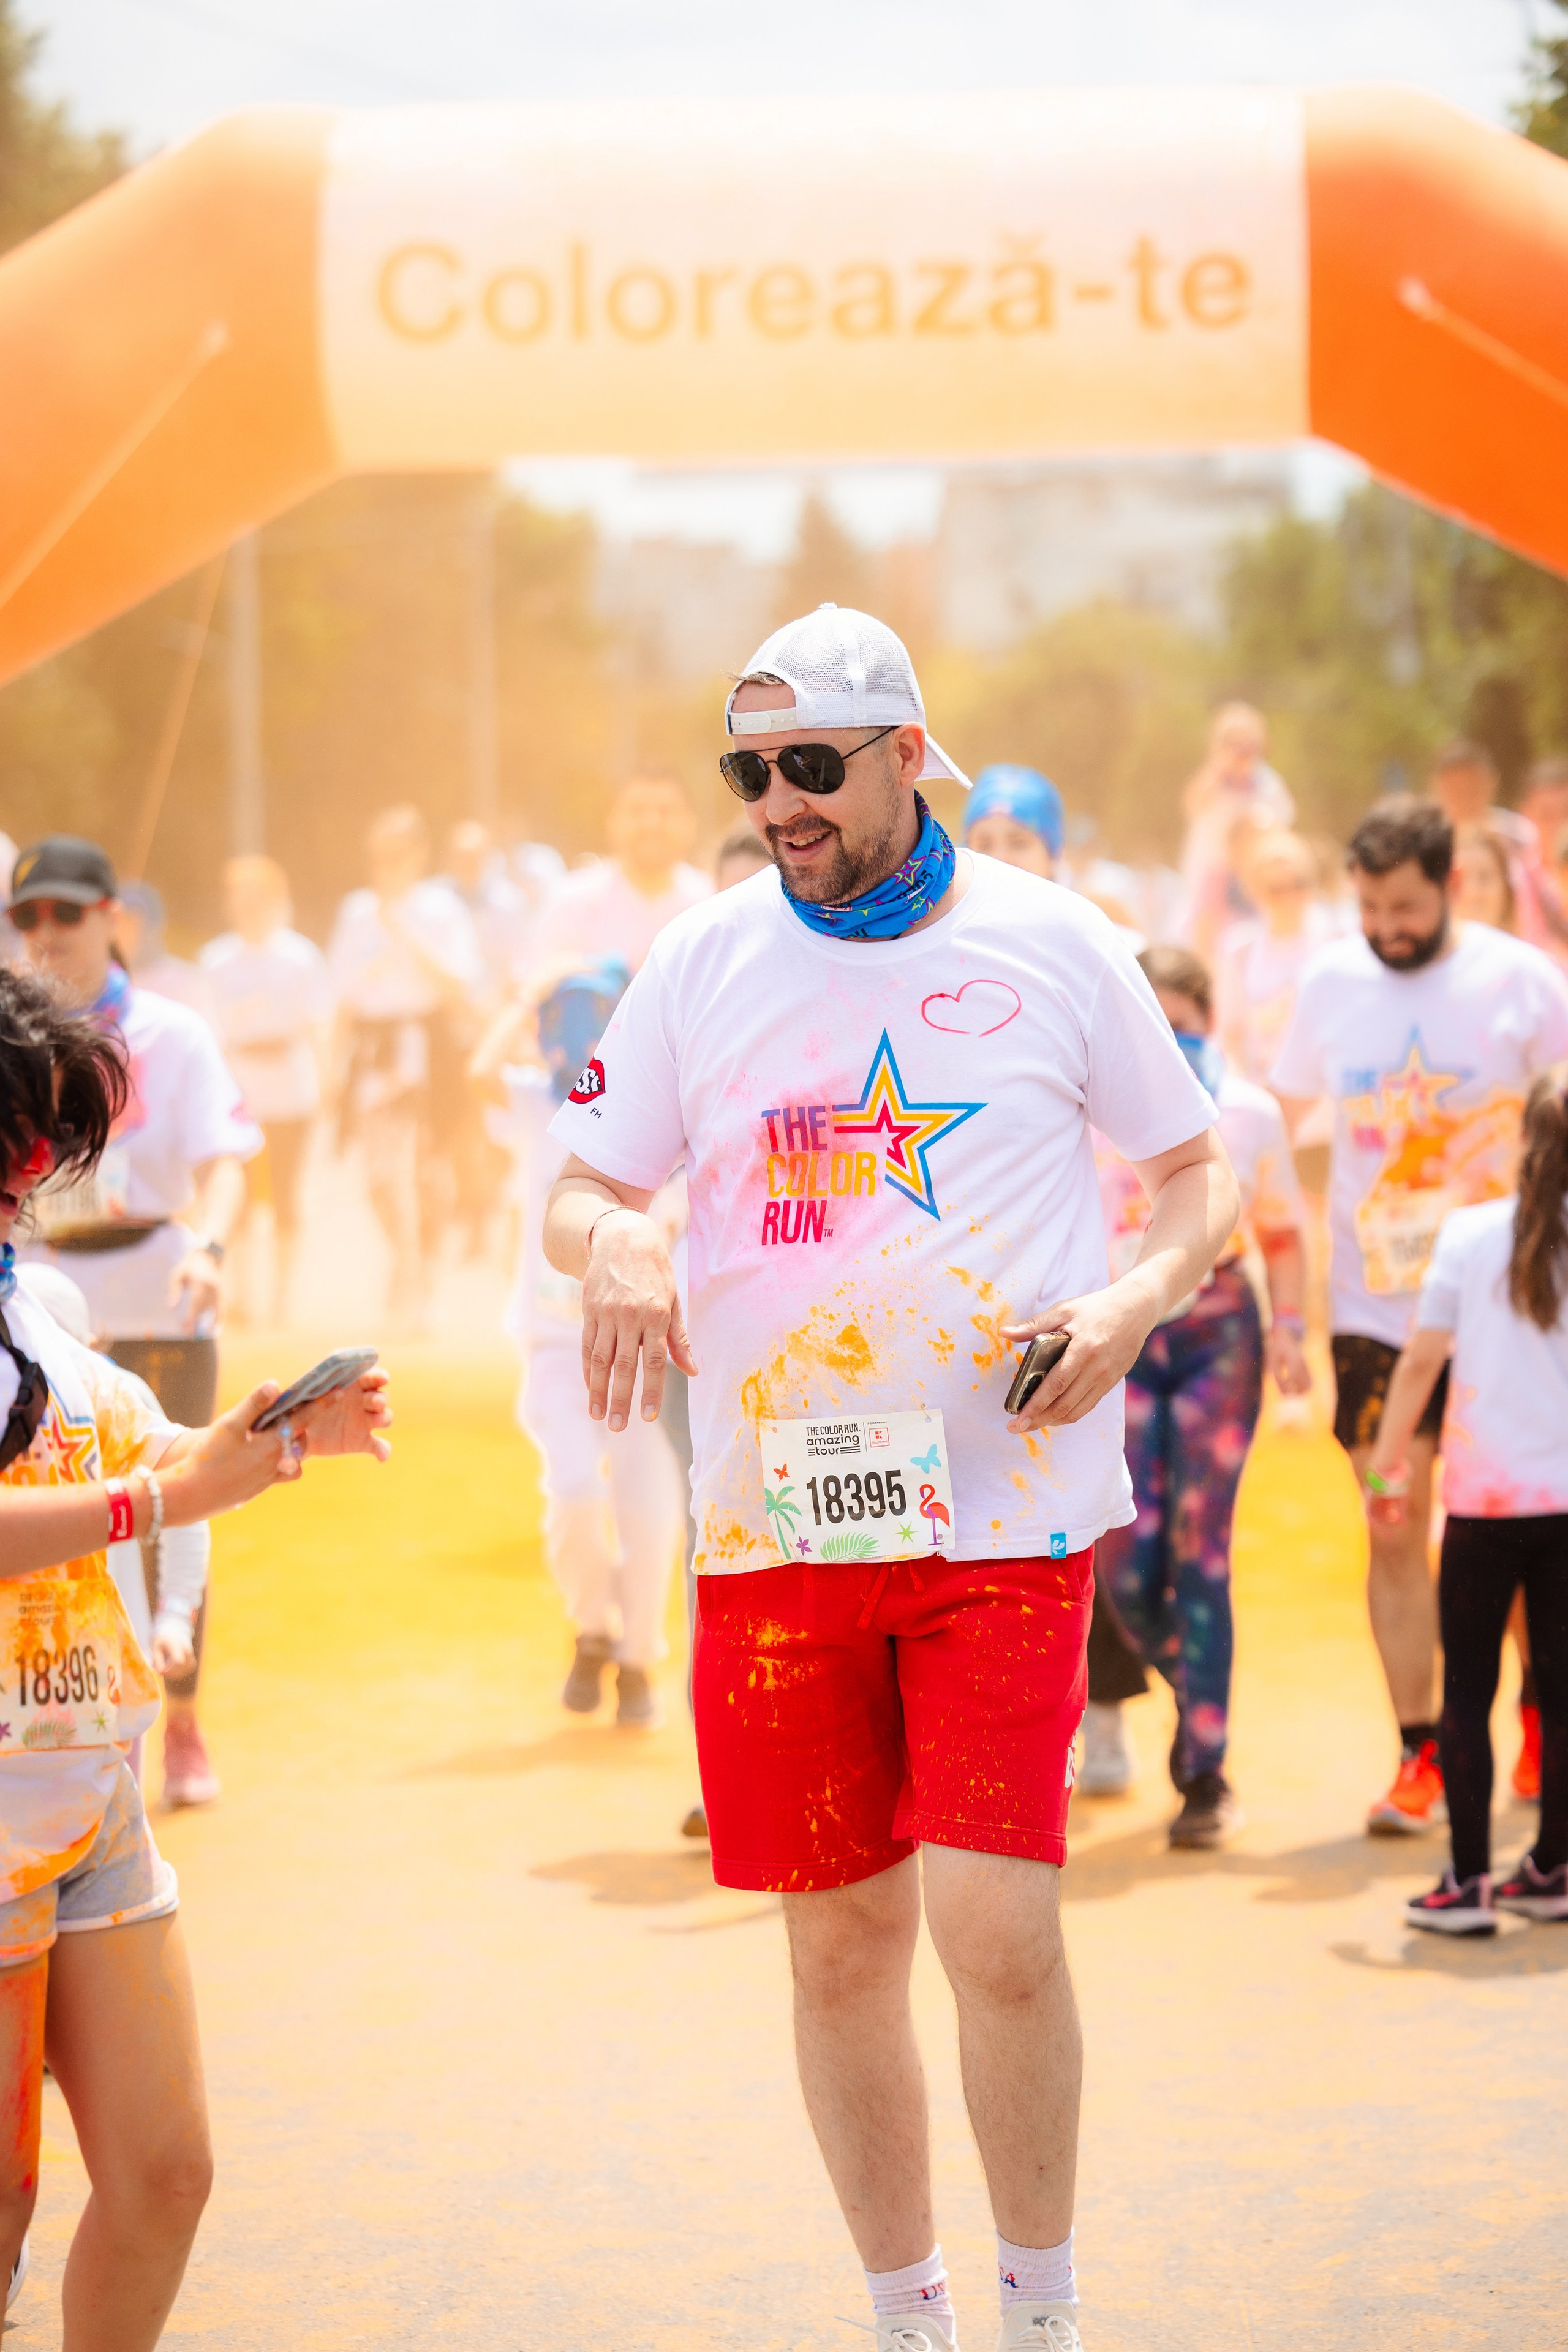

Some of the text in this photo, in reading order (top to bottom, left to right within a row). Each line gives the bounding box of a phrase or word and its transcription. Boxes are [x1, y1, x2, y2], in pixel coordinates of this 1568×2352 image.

[376, 232, 1253, 345] Colorează-te
[590, 1107, 603, 1120] FM
[761, 1105, 828, 1153] THE
[766, 1151, 877, 1198] COLOR
[806, 1426, 820, 1436] THE
[820, 1425, 843, 1435] COLOR
[806, 1434, 860, 1446] amazing
[815, 1446, 839, 1456] tour
[806, 1469, 907, 1526] 18395
[15, 1645, 99, 1706] 18396
